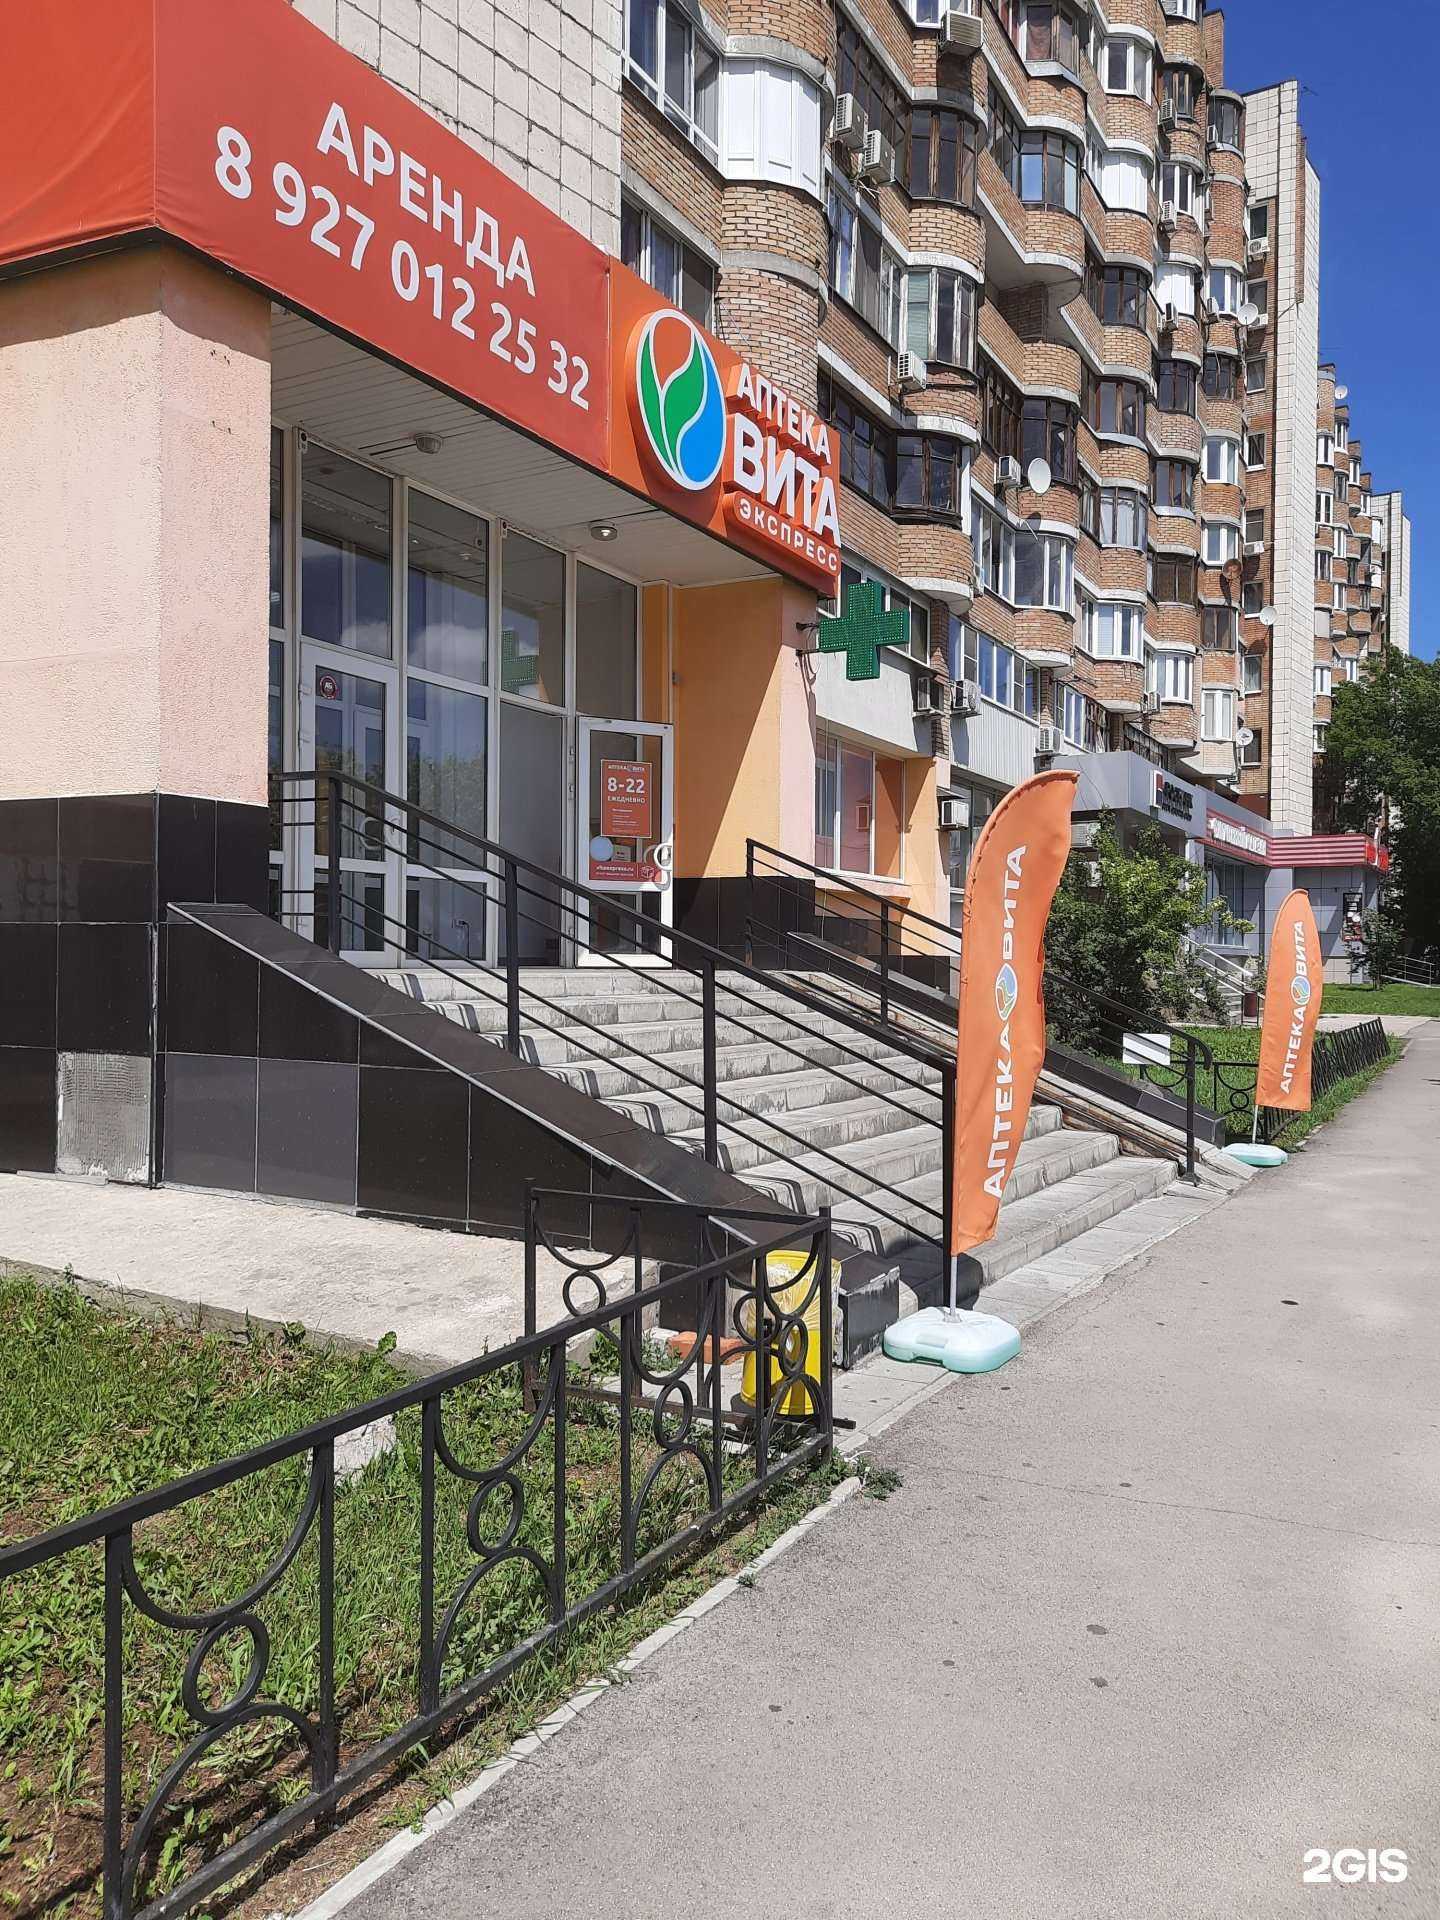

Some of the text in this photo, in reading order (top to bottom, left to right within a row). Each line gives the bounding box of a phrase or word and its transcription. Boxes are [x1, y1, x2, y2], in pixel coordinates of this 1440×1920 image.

[316, 101, 536, 297] АРЕНДА
[214, 125, 589, 411] 8 927 012 25 32
[731, 412, 842, 549] ВИТА
[736, 362, 832, 465] АПТЕКА
[739, 498, 838, 571] ЭКСПРЕСС
[607, 776, 645, 794] 8-22
[607, 795, 646, 804] ЕЖЕДНЕВНО
[983, 844, 1027, 1199] АПТЕКА ВИТА
[1280, 920, 1308, 1095] АПТЕКА ВИТА
